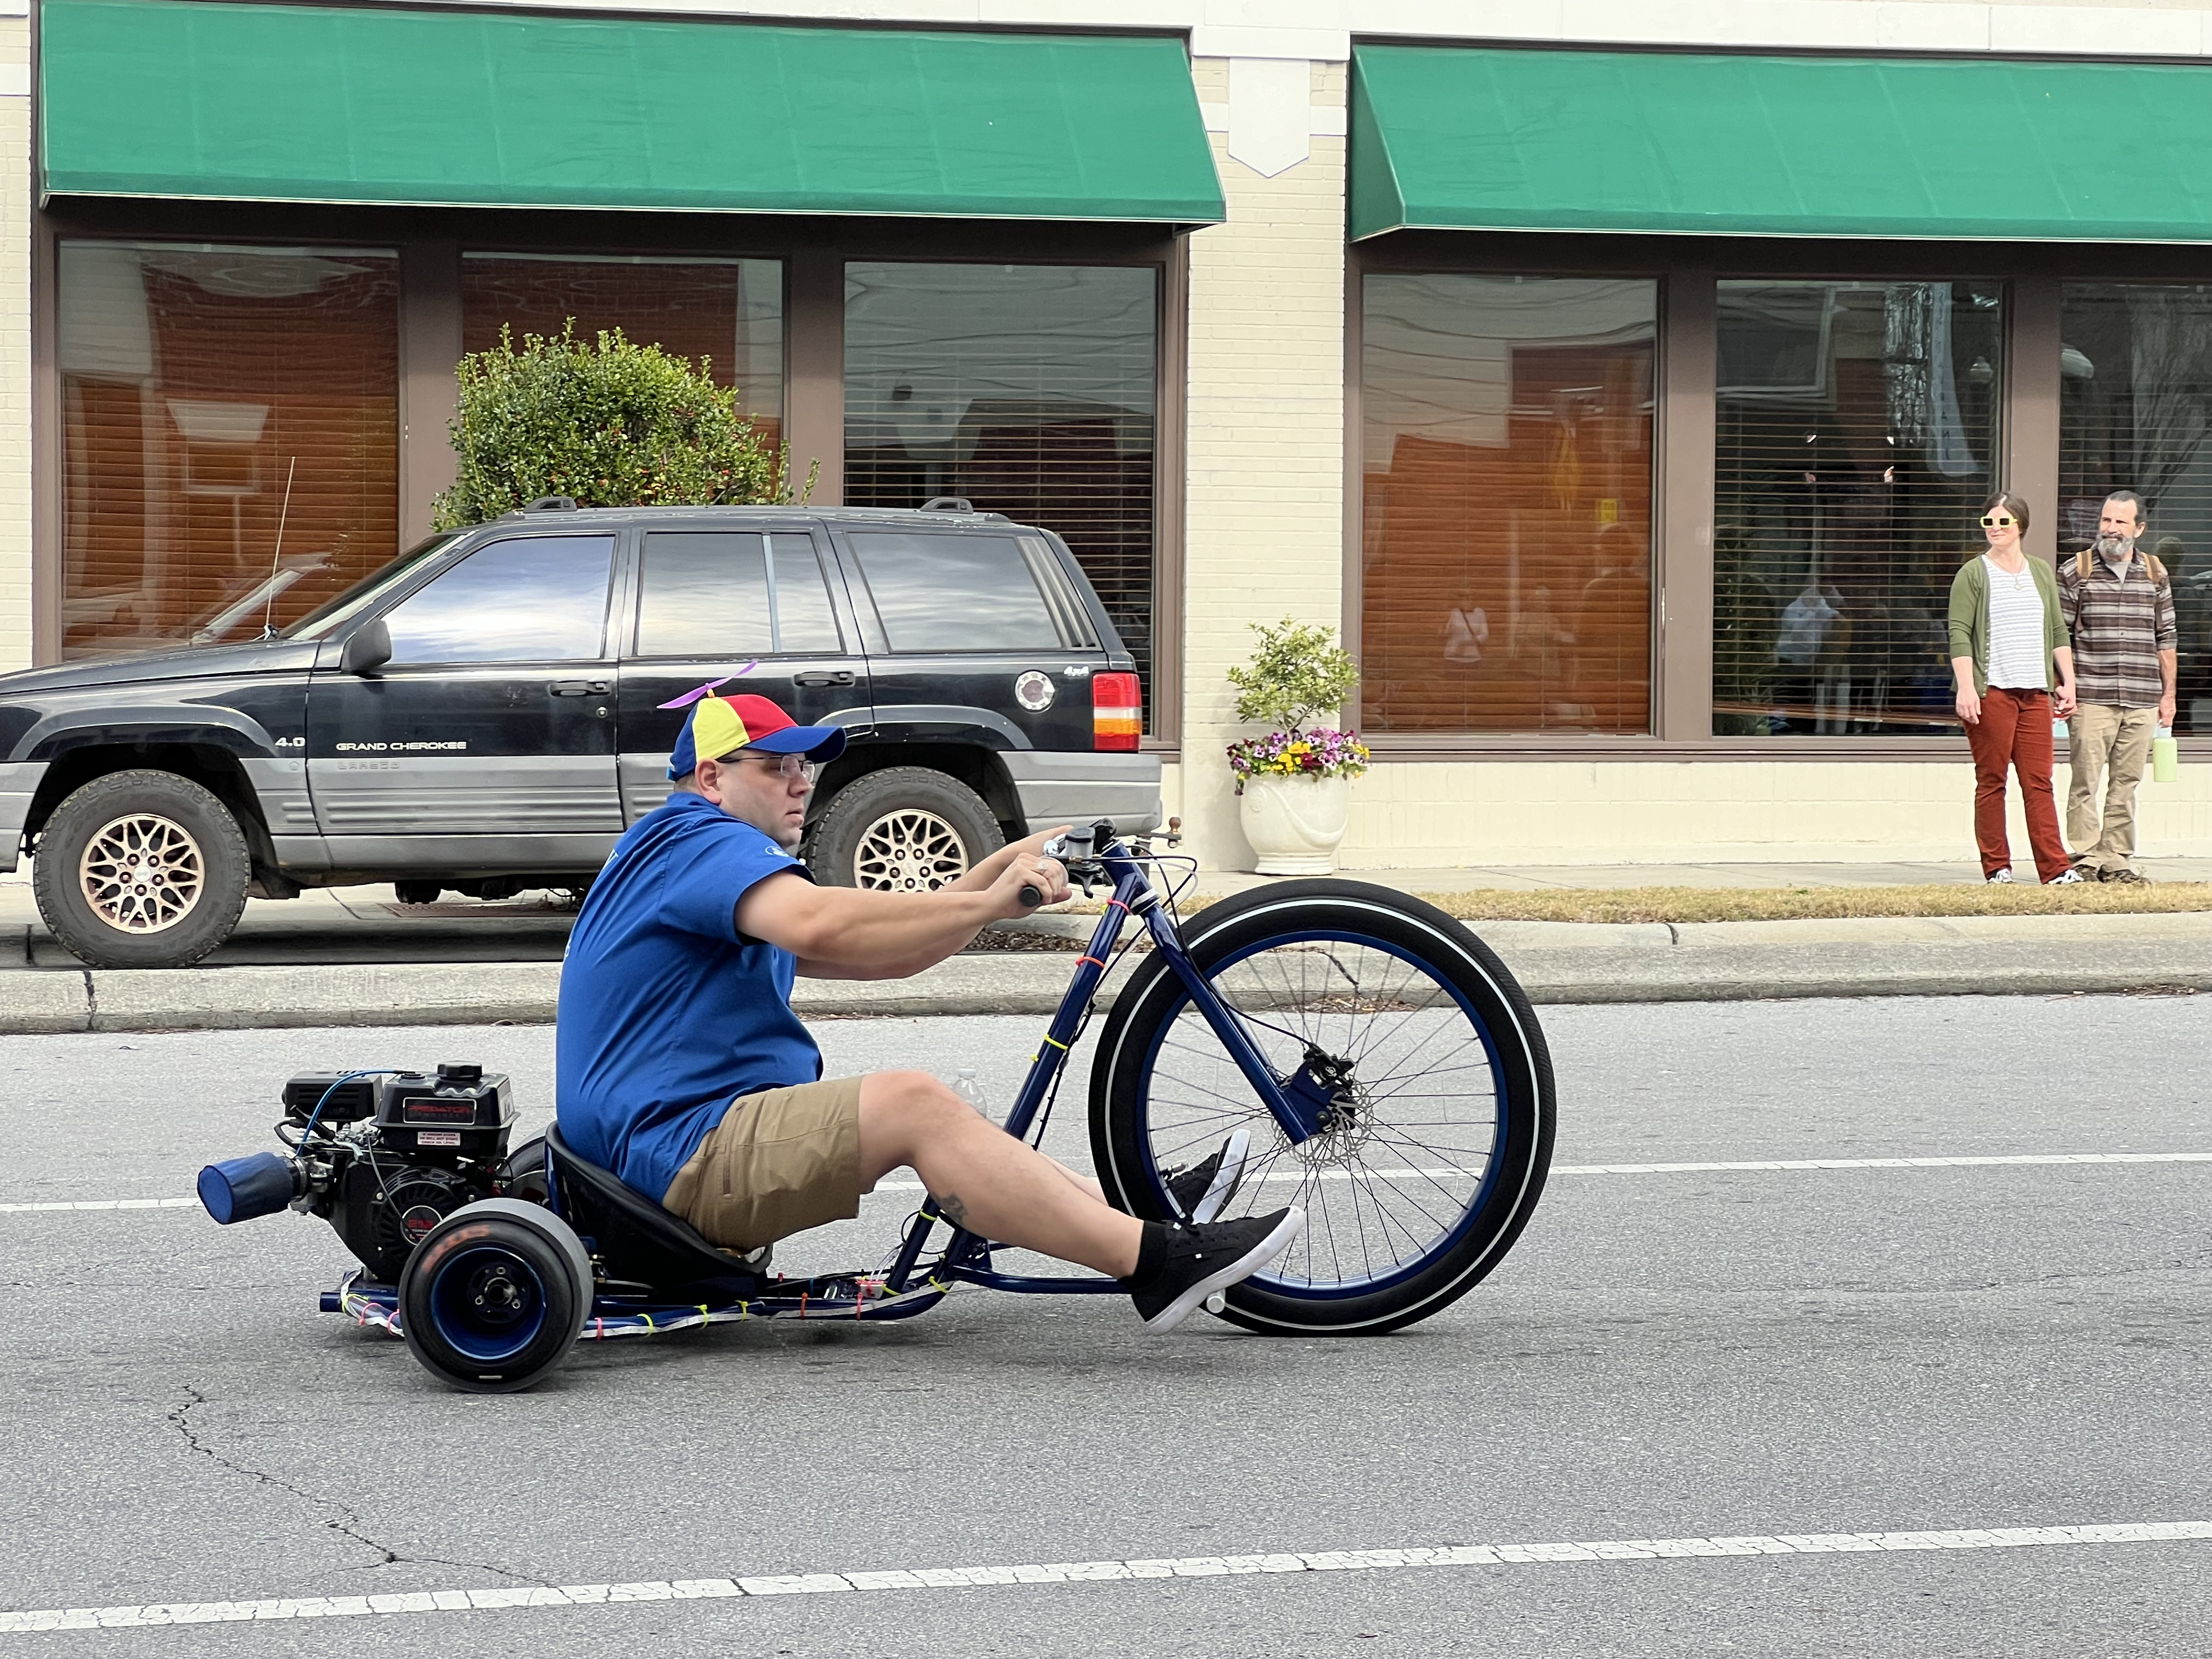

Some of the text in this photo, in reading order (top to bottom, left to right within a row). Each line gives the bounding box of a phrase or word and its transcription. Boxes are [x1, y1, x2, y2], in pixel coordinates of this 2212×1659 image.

[275, 737, 305, 747] 4.0
[336, 742, 467, 751] GRAND CHEROKEE
[338, 761, 400, 770] LAREDO
